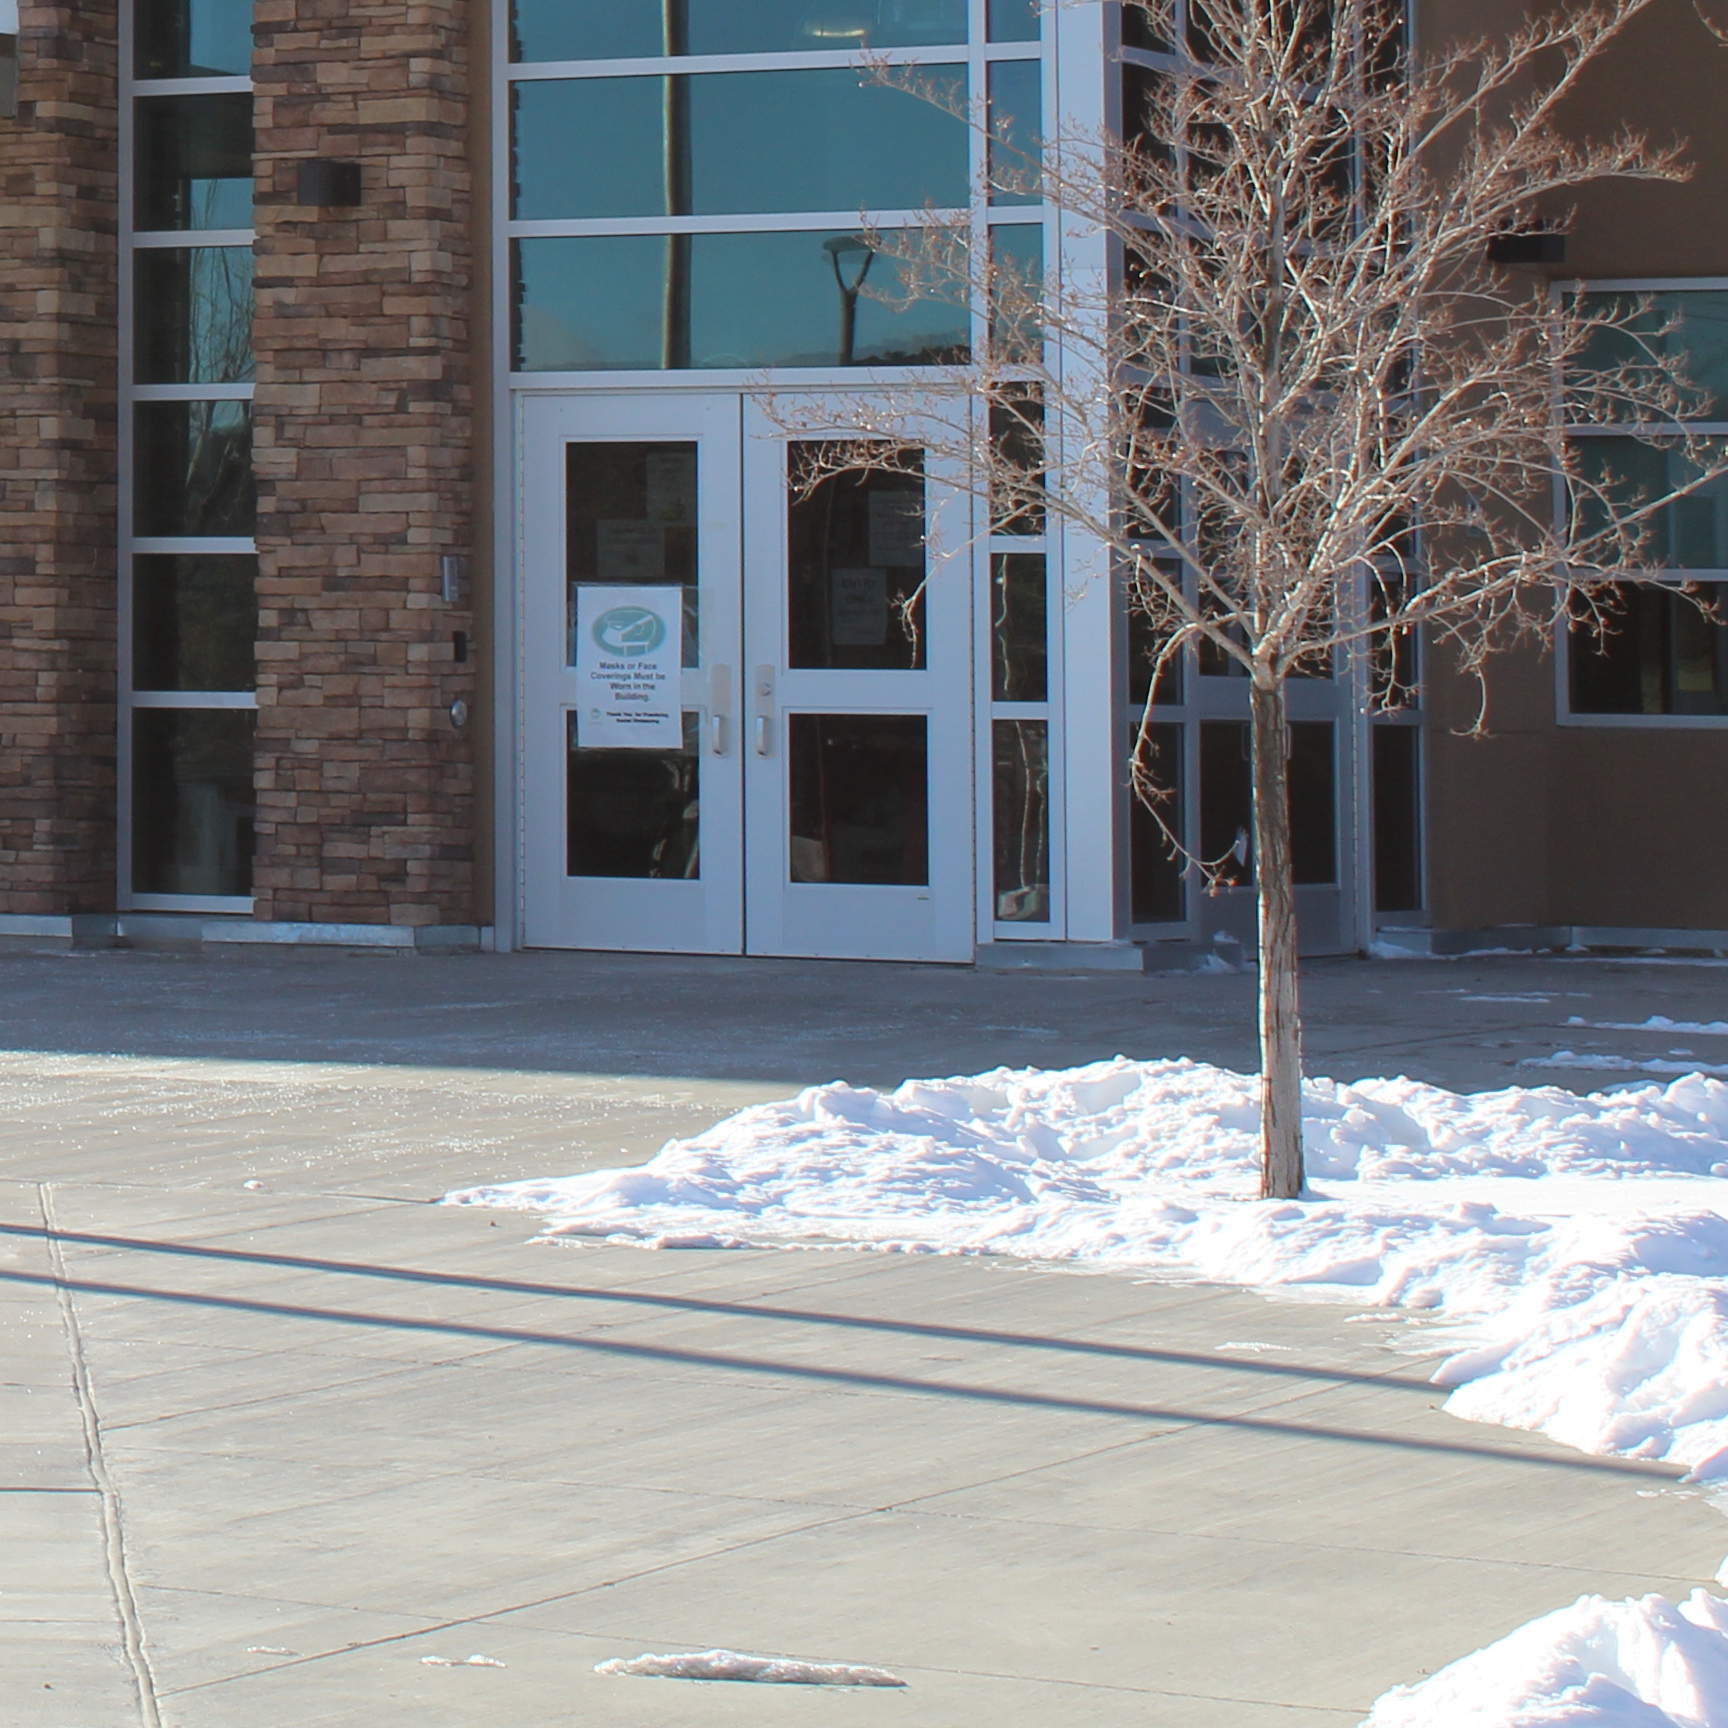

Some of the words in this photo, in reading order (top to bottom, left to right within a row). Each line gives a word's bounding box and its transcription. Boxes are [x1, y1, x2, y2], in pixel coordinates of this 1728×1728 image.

[599, 662, 625, 670] Masks
[638, 662, 657, 670] Face
[590, 672, 631, 682] Coverings
[634, 672, 654, 680] Must
[655, 672, 666, 680] be
[610, 682, 631, 690] Worn
[633, 682, 641, 690] in
[643, 682, 656, 690] the
